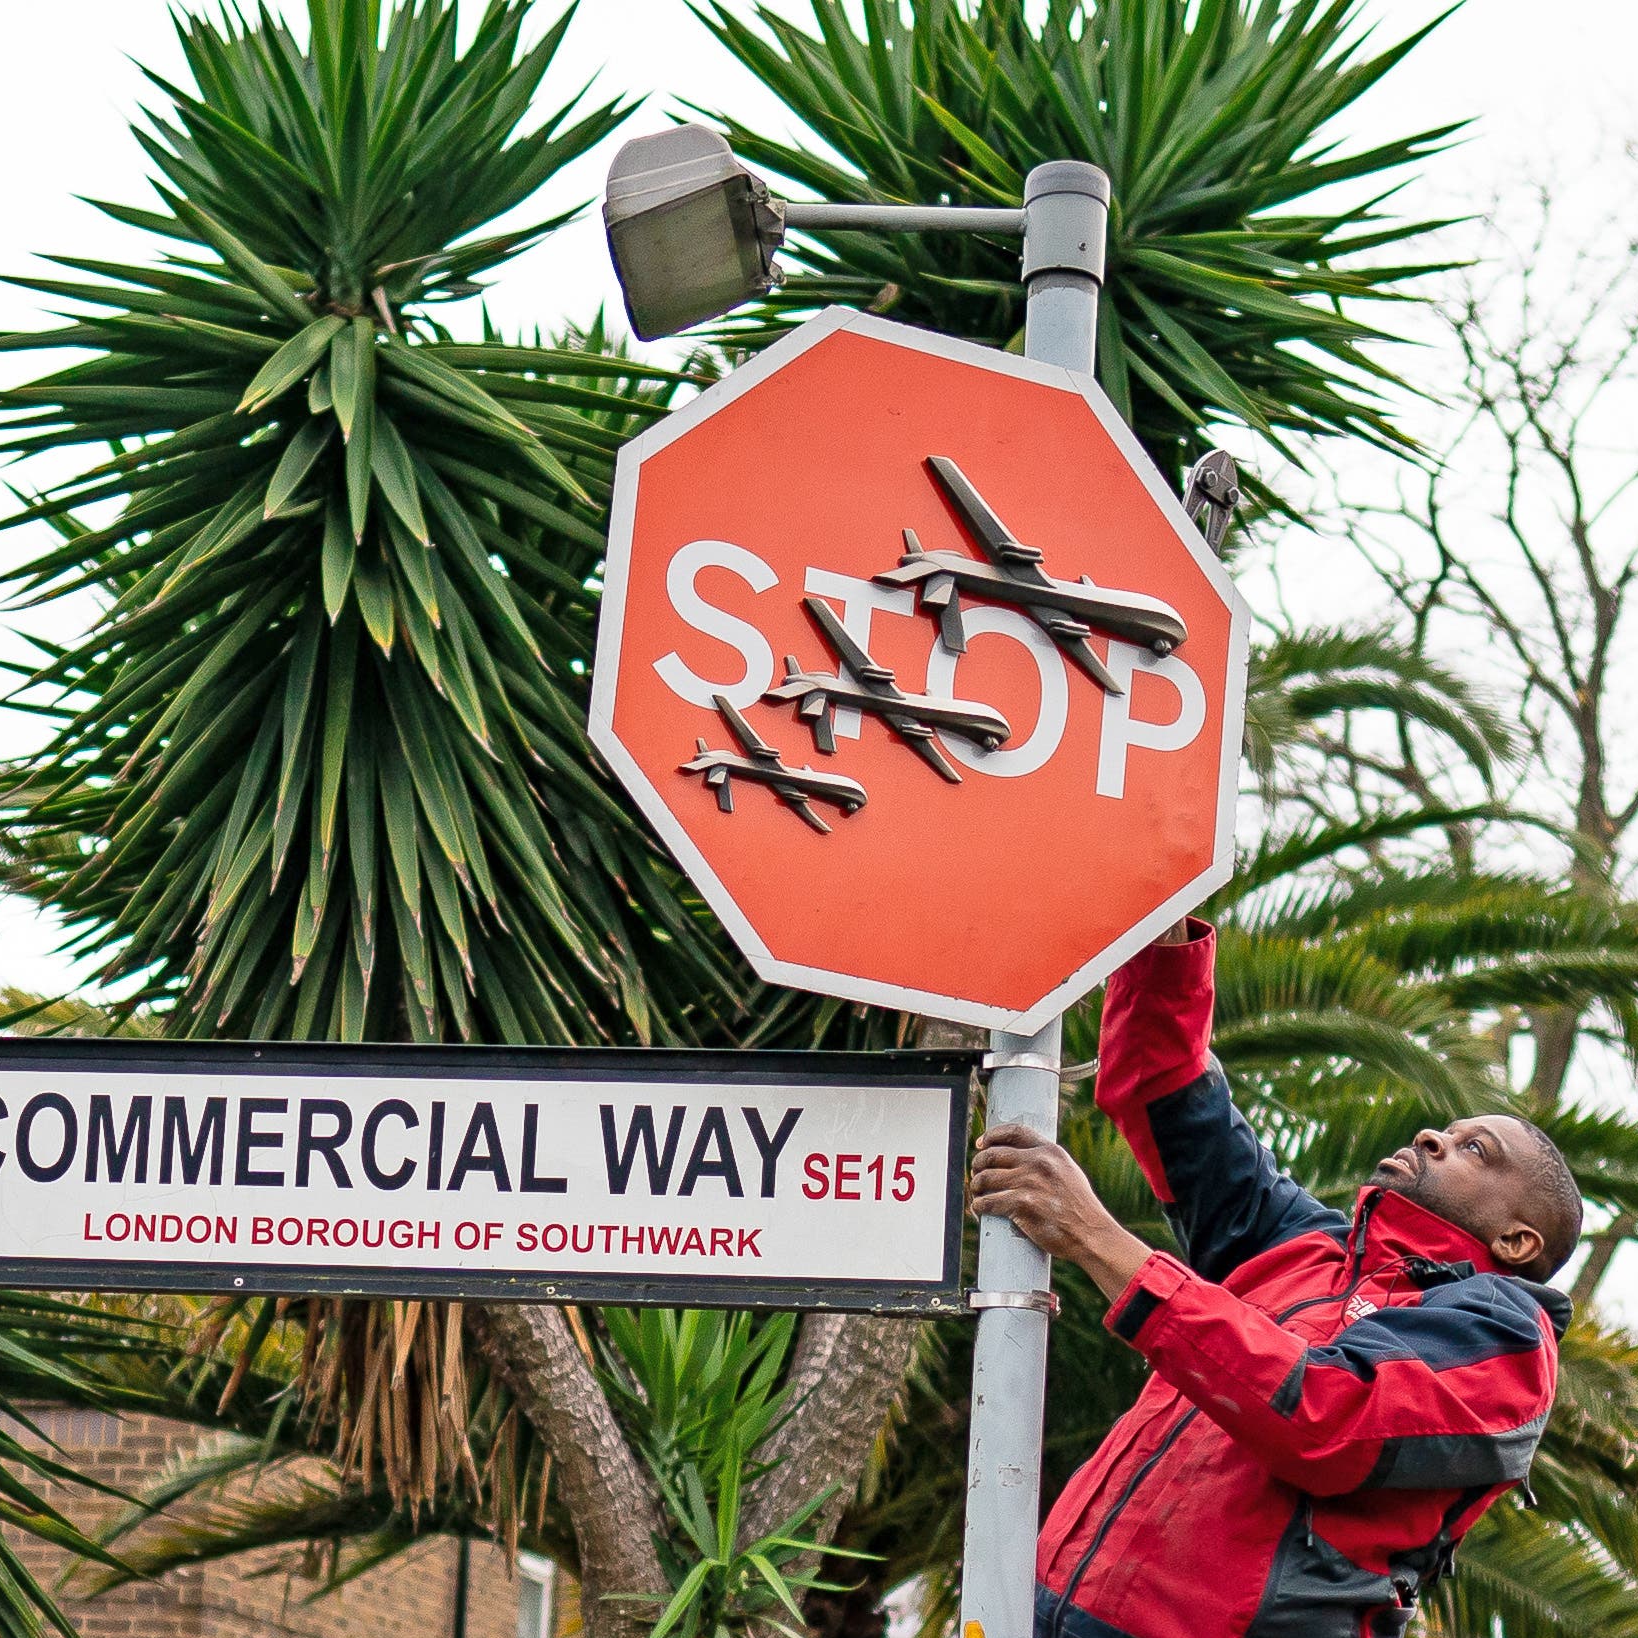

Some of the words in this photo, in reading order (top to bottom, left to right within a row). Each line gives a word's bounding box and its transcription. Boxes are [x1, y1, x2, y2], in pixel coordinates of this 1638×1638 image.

[653, 540, 1208, 800] STOP
[599, 1104, 804, 1199] WAY
[801, 1152, 917, 1202] SE15
[83, 1212, 238, 1245] LONDON
[251, 1215, 442, 1250] BOROUGH
[454, 1221, 505, 1251] OF
[516, 1223, 764, 1258] SOUTHWARK
